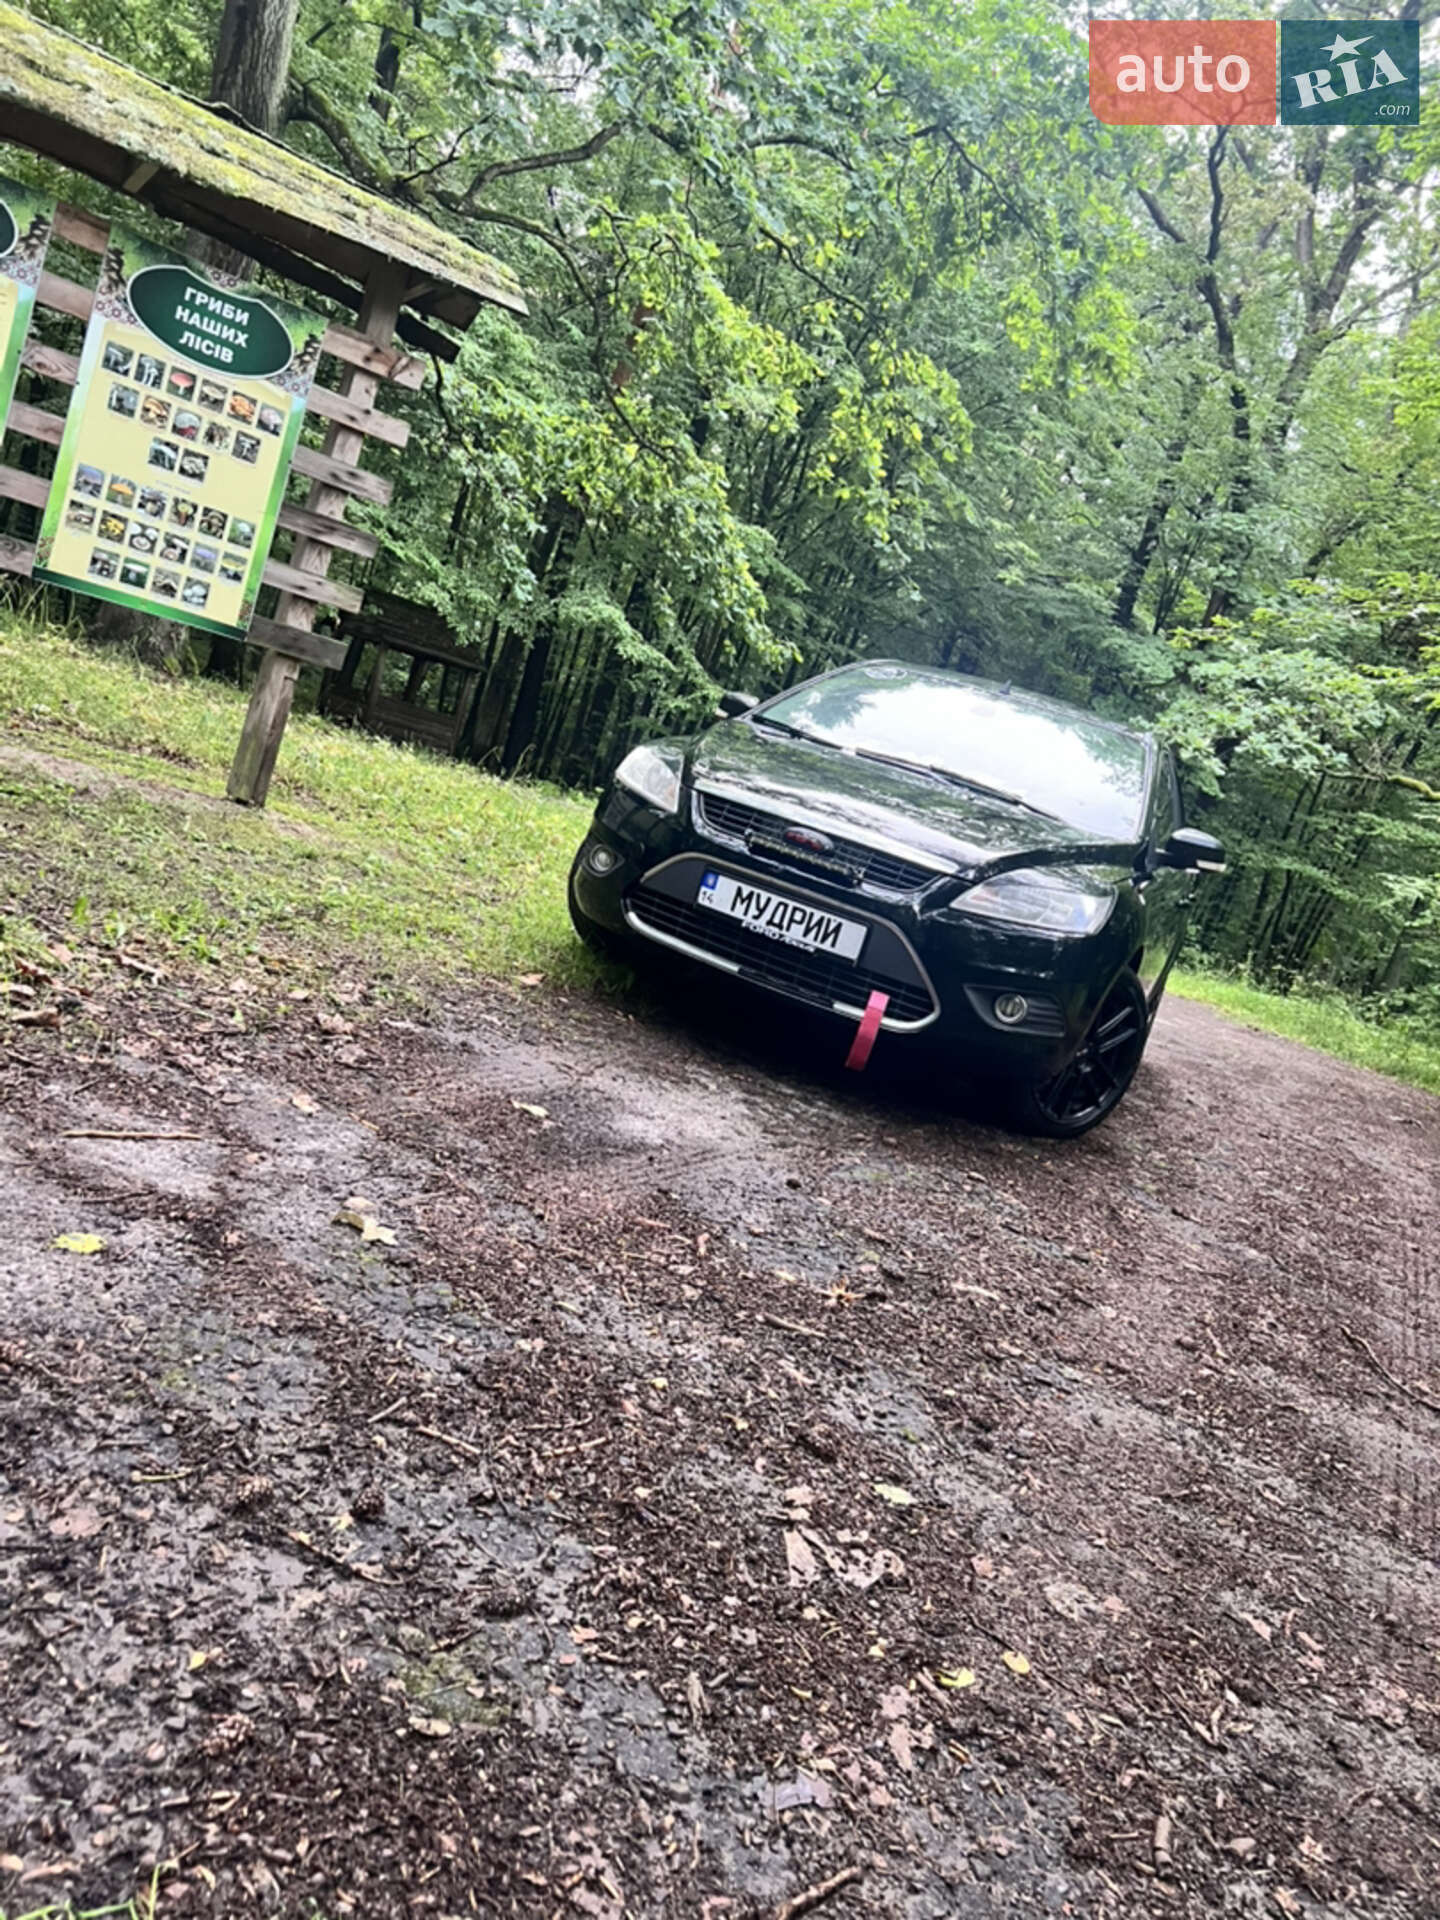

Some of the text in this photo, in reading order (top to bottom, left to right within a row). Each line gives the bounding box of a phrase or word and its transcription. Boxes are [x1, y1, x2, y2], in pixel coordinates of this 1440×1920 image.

[184, 286, 250, 326] ГРИБИ
[175, 305, 249, 348] НАШИХ
[179, 331, 234, 363] ЛІСІВ
